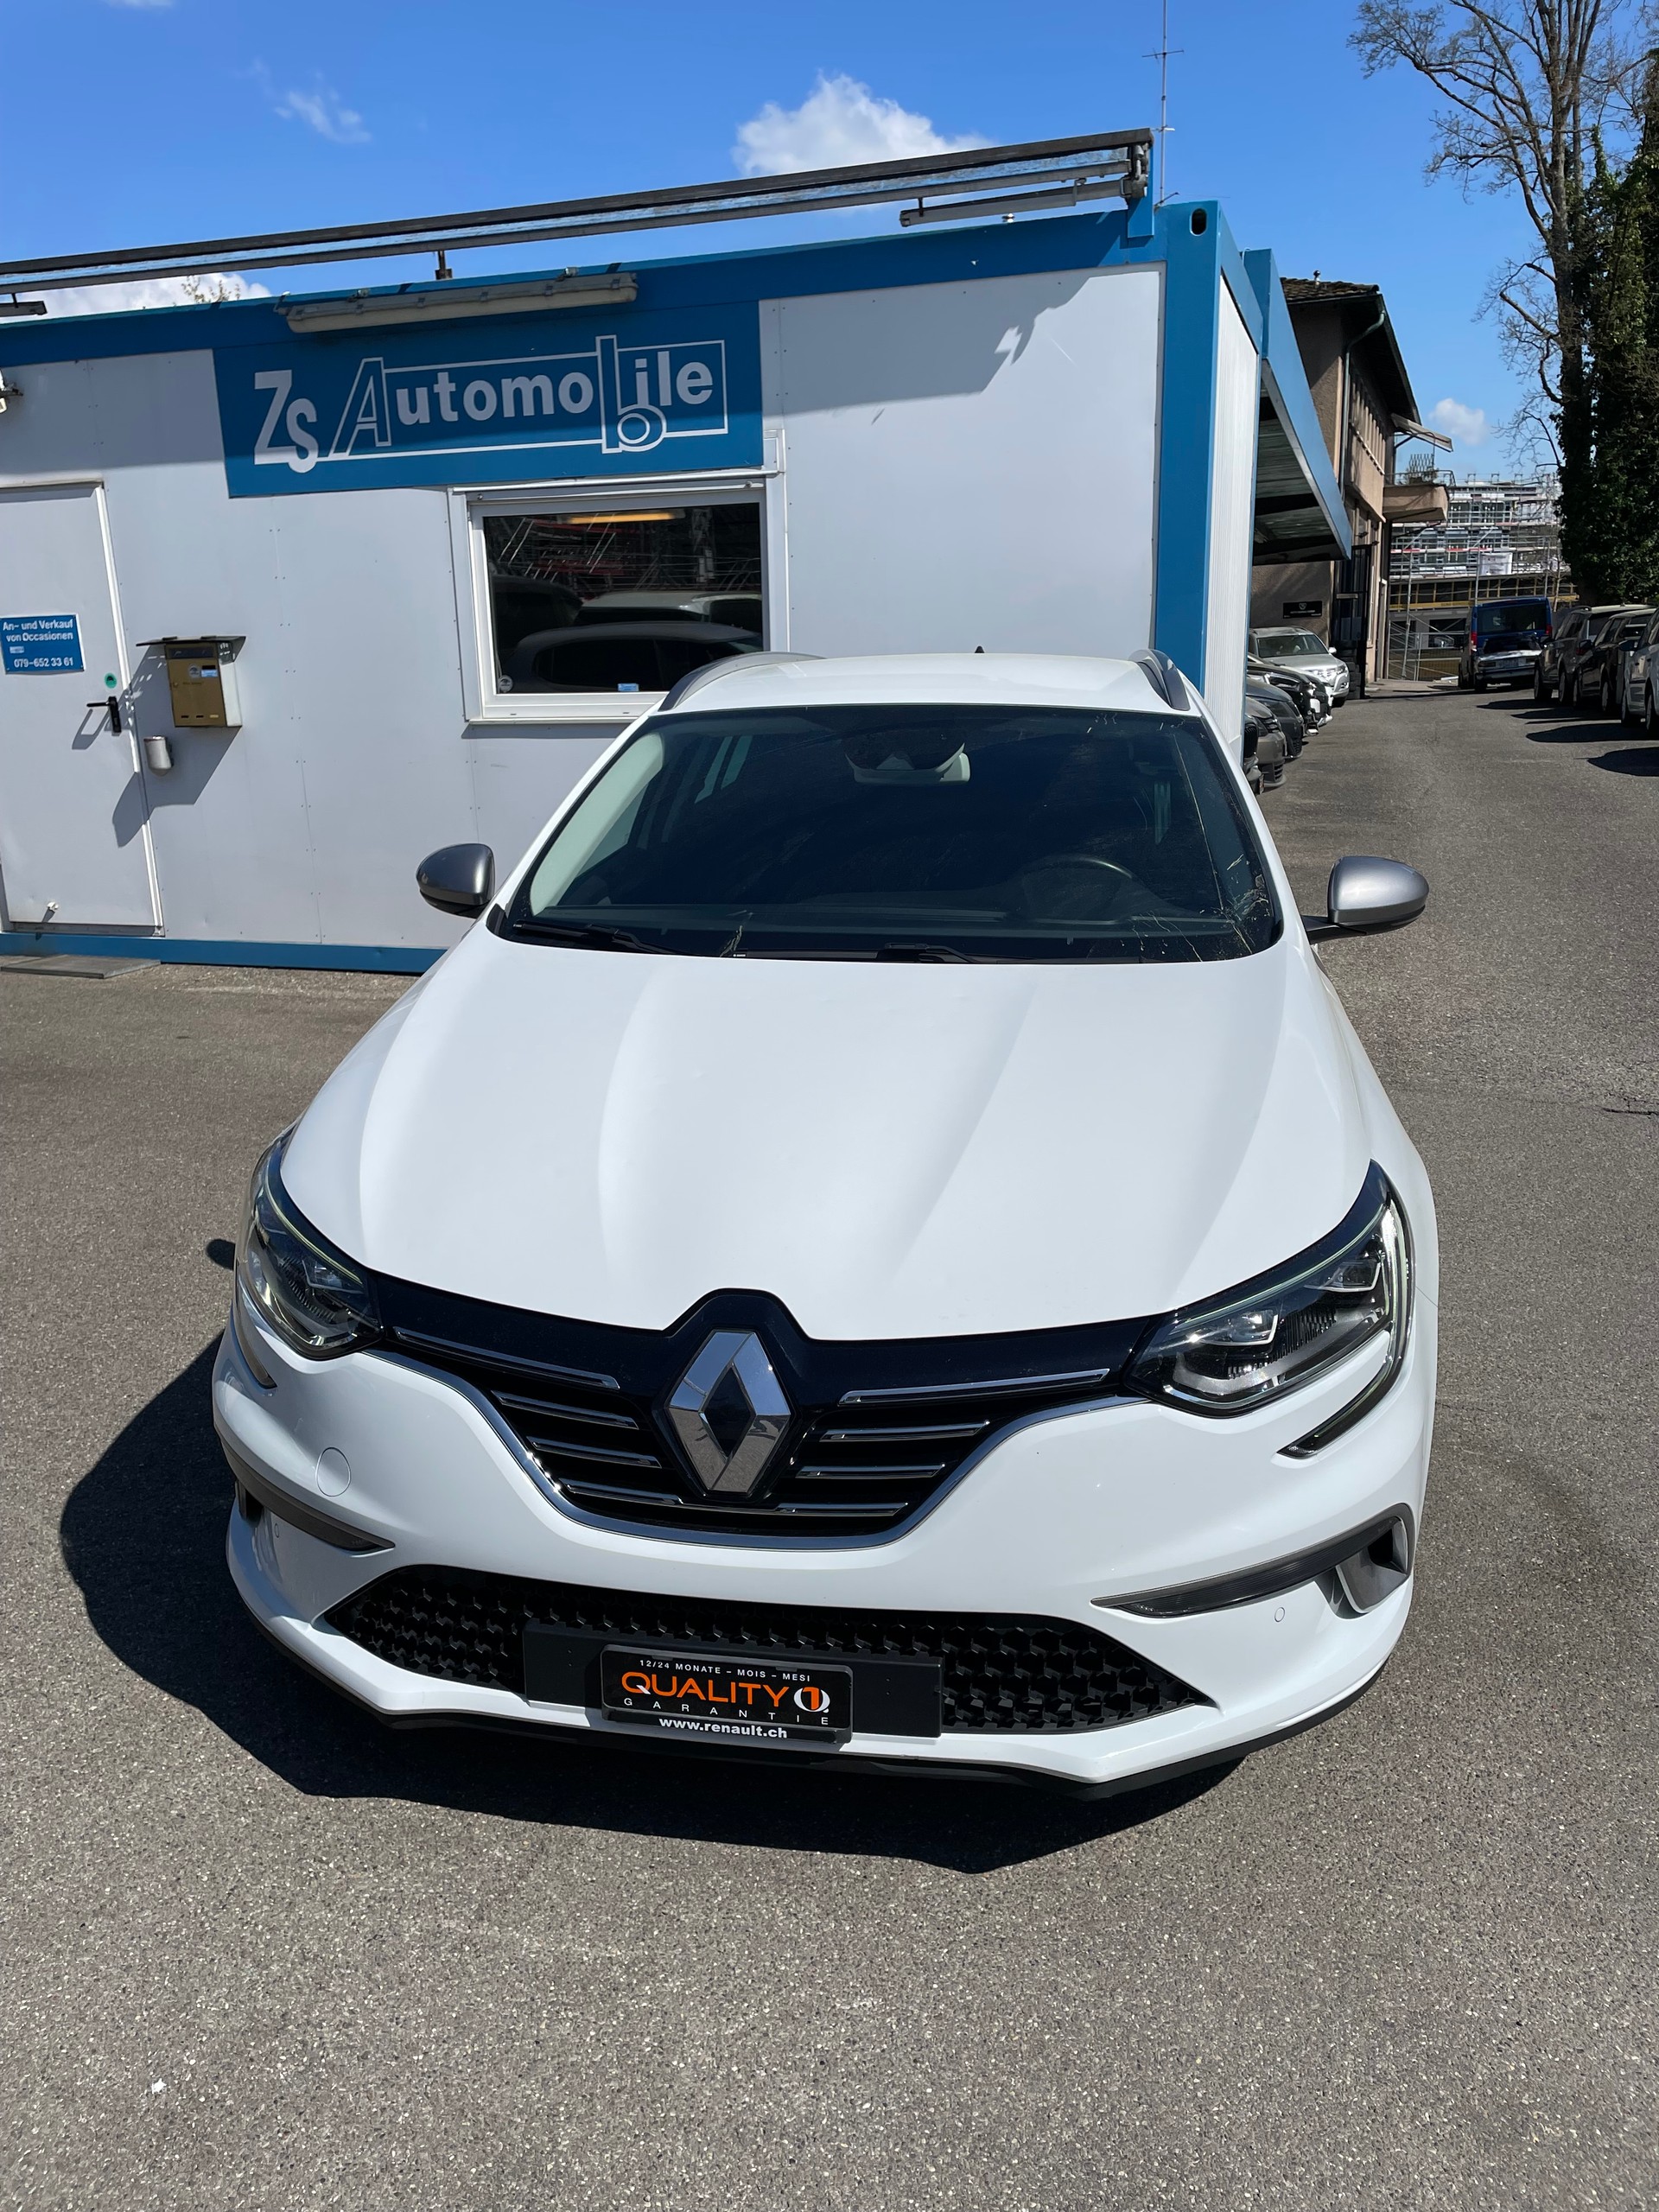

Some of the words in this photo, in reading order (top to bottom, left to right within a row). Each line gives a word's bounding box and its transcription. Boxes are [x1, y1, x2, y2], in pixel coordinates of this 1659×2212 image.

[254, 370, 318, 474] Zs
[3, 621, 19, 631] An-
[21, 620, 38, 630] und
[39, 619, 73, 630] Verkauf
[6, 633, 22, 642] von
[22, 631, 73, 642] Occasionen
[14, 658, 49, 668] 079-652
[51, 657, 62, 667] 33
[63, 657, 73, 666] 61
[639, 1659, 671, 1670] 12/24
[675, 1662, 721, 1675] MONATE
[737, 1669, 766, 1678] MOIS
[782, 1672, 811, 1682] MESI
[621, 1671, 790, 1707] QUALITY
[623, 1697, 829, 1726] GARANTIE
[658, 1716, 787, 1738] www.renault.ch
